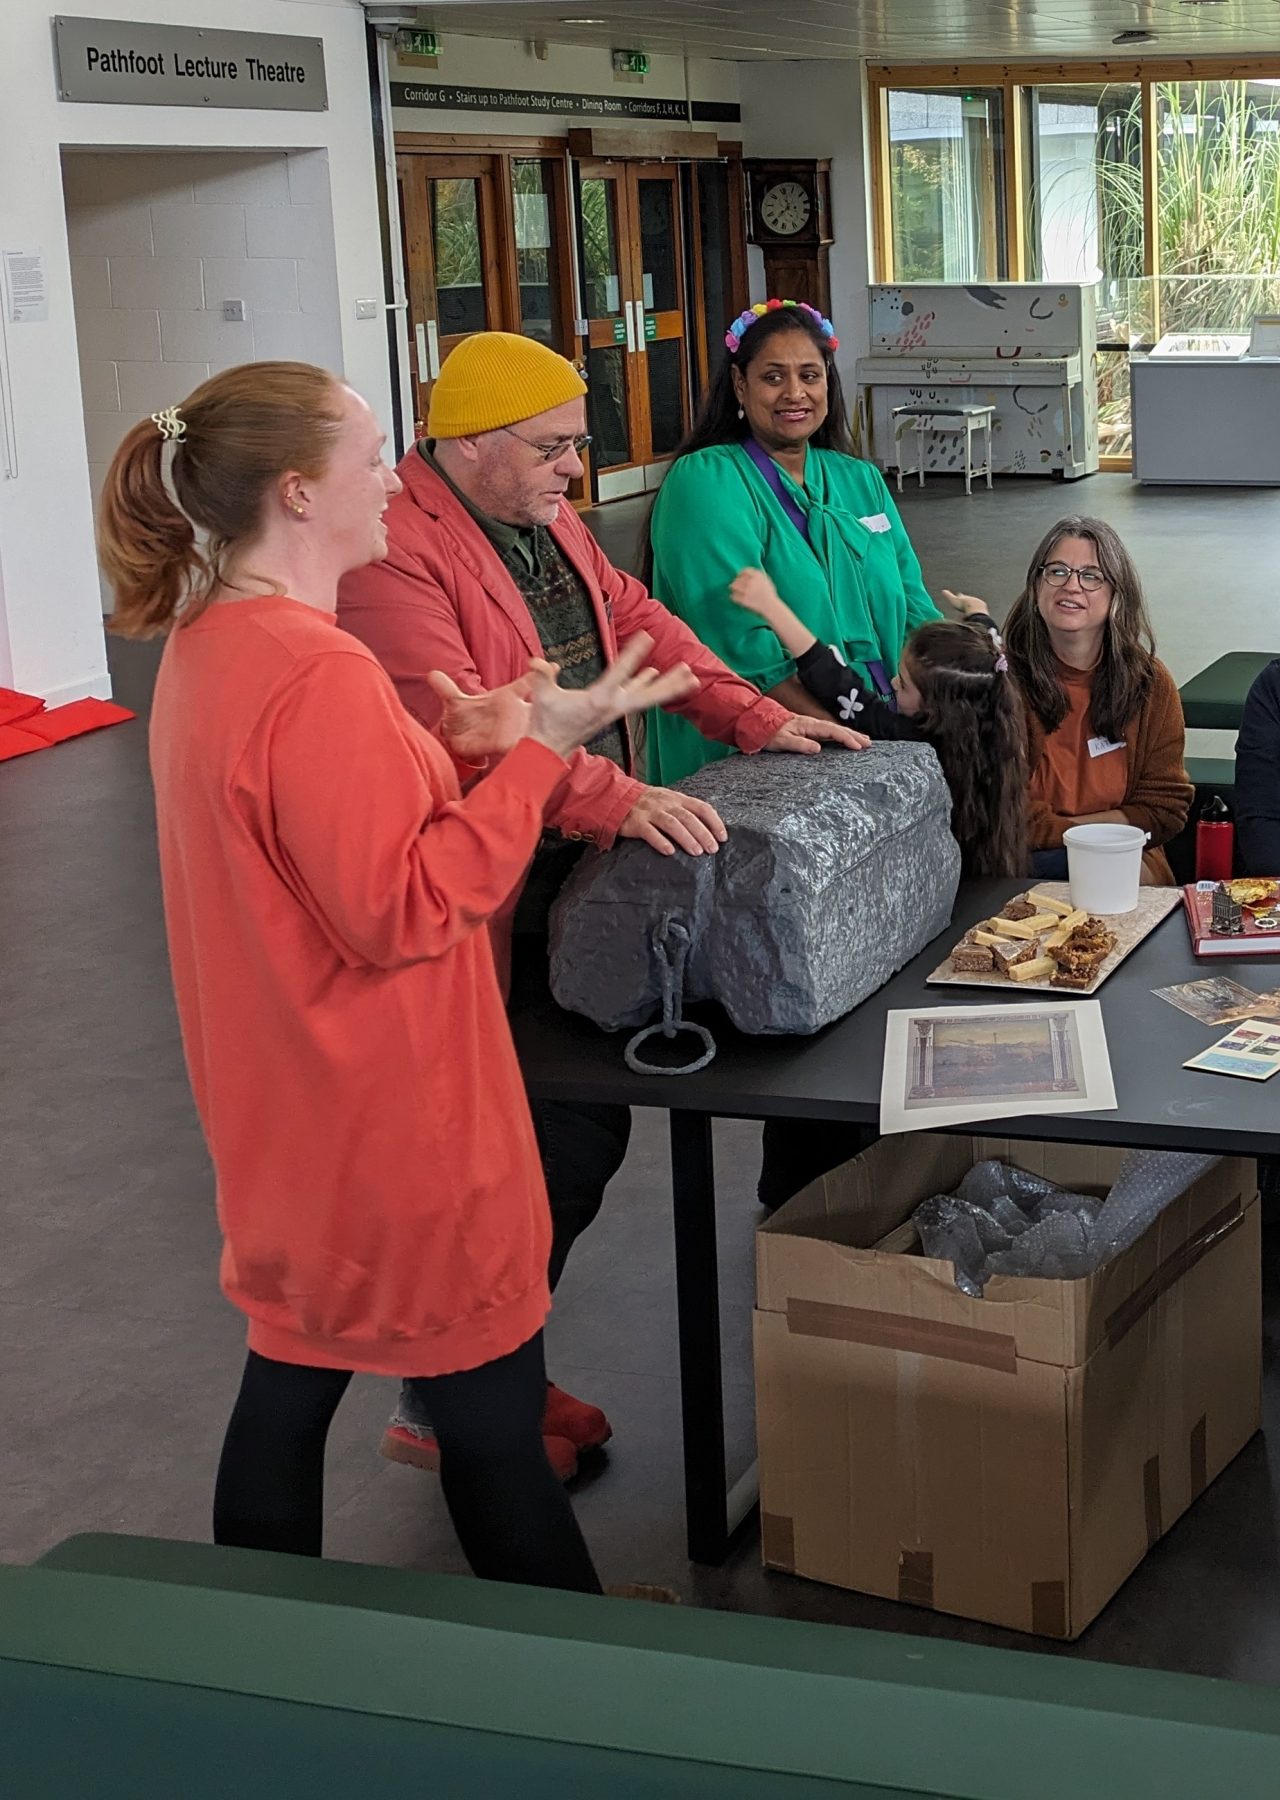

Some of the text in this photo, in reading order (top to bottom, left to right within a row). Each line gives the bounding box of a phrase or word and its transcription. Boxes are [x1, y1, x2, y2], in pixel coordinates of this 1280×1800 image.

[86, 46, 306, 84] Pathfoot Lecture Theatre
[404, 87, 437, 101] Corridor
[439, 89, 446, 102] G
[455, 90, 477, 104] Stairs
[478, 94, 488, 106] up
[489, 94, 498, 105] to
[499, 93, 530, 107] Pathfoot
[530, 95, 550, 110] Study
[551, 96, 574, 109] Centre
[581, 98, 603, 113] Dining
[604, 99, 622, 111] Room
[628, 101, 656, 113] Corridors
